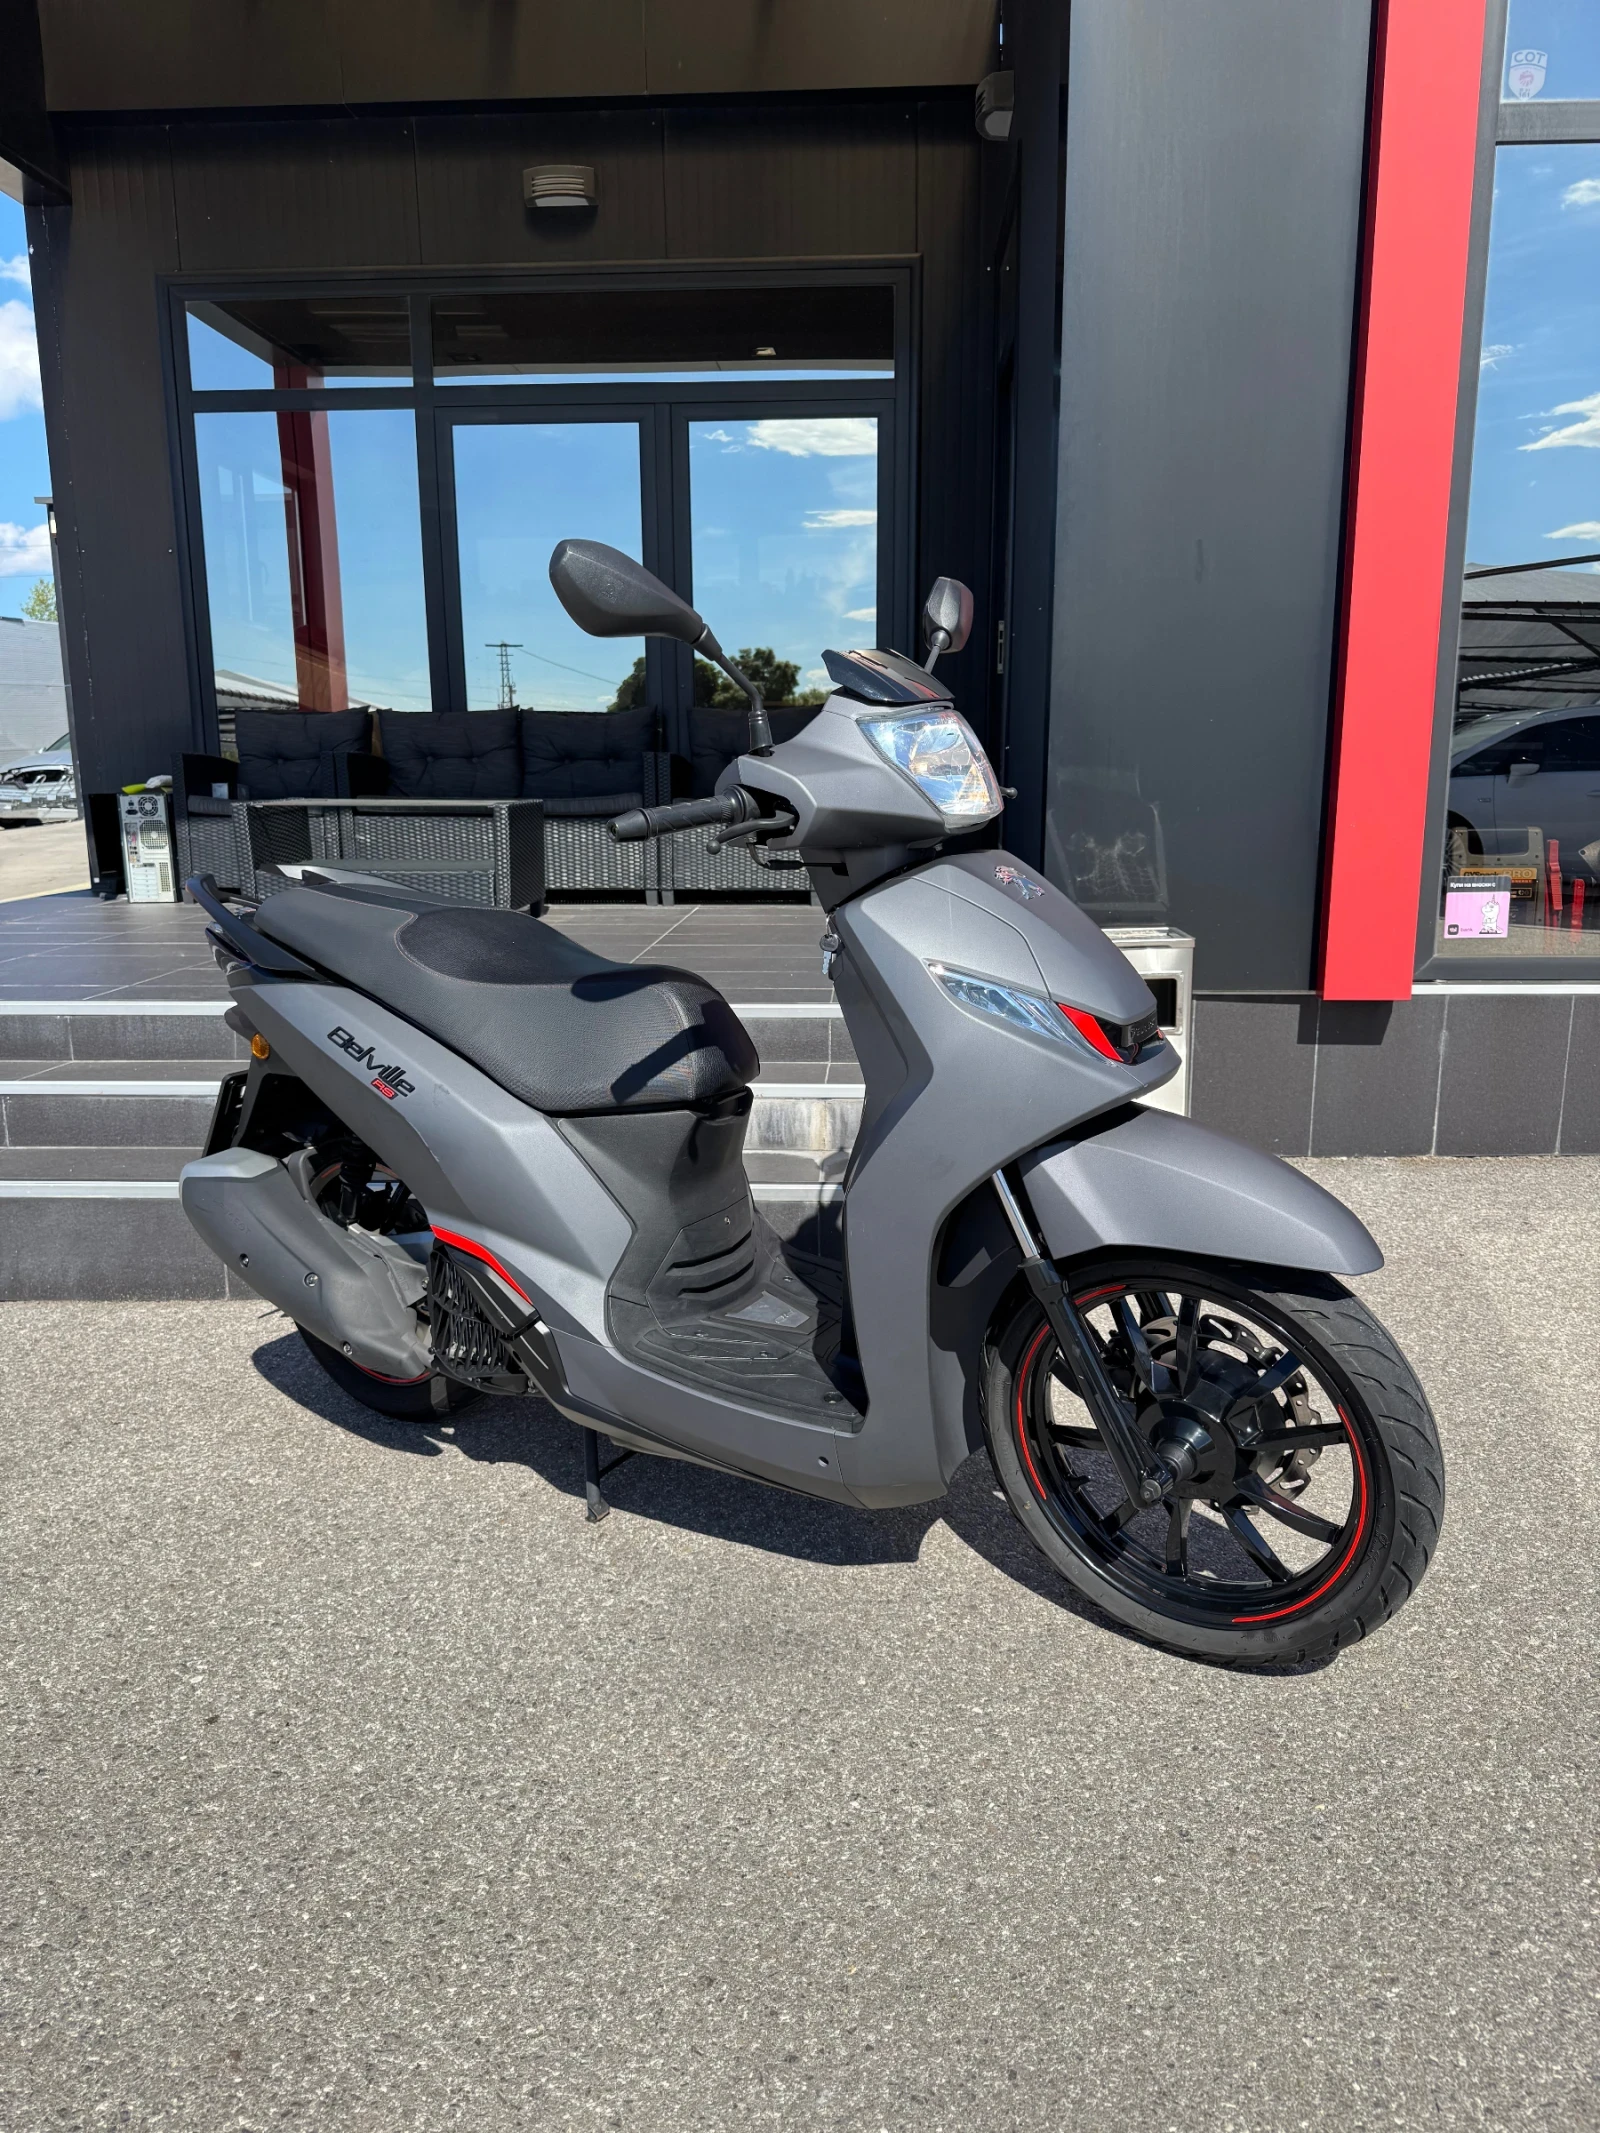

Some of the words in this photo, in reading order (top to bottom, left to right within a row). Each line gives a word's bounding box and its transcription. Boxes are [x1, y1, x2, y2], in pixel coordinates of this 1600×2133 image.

[1514, 52, 1546, 64] COT
[1503, 869, 1532, 878] PRO
[326, 1025, 416, 1098] Belville
[371, 1079, 397, 1099] RS
